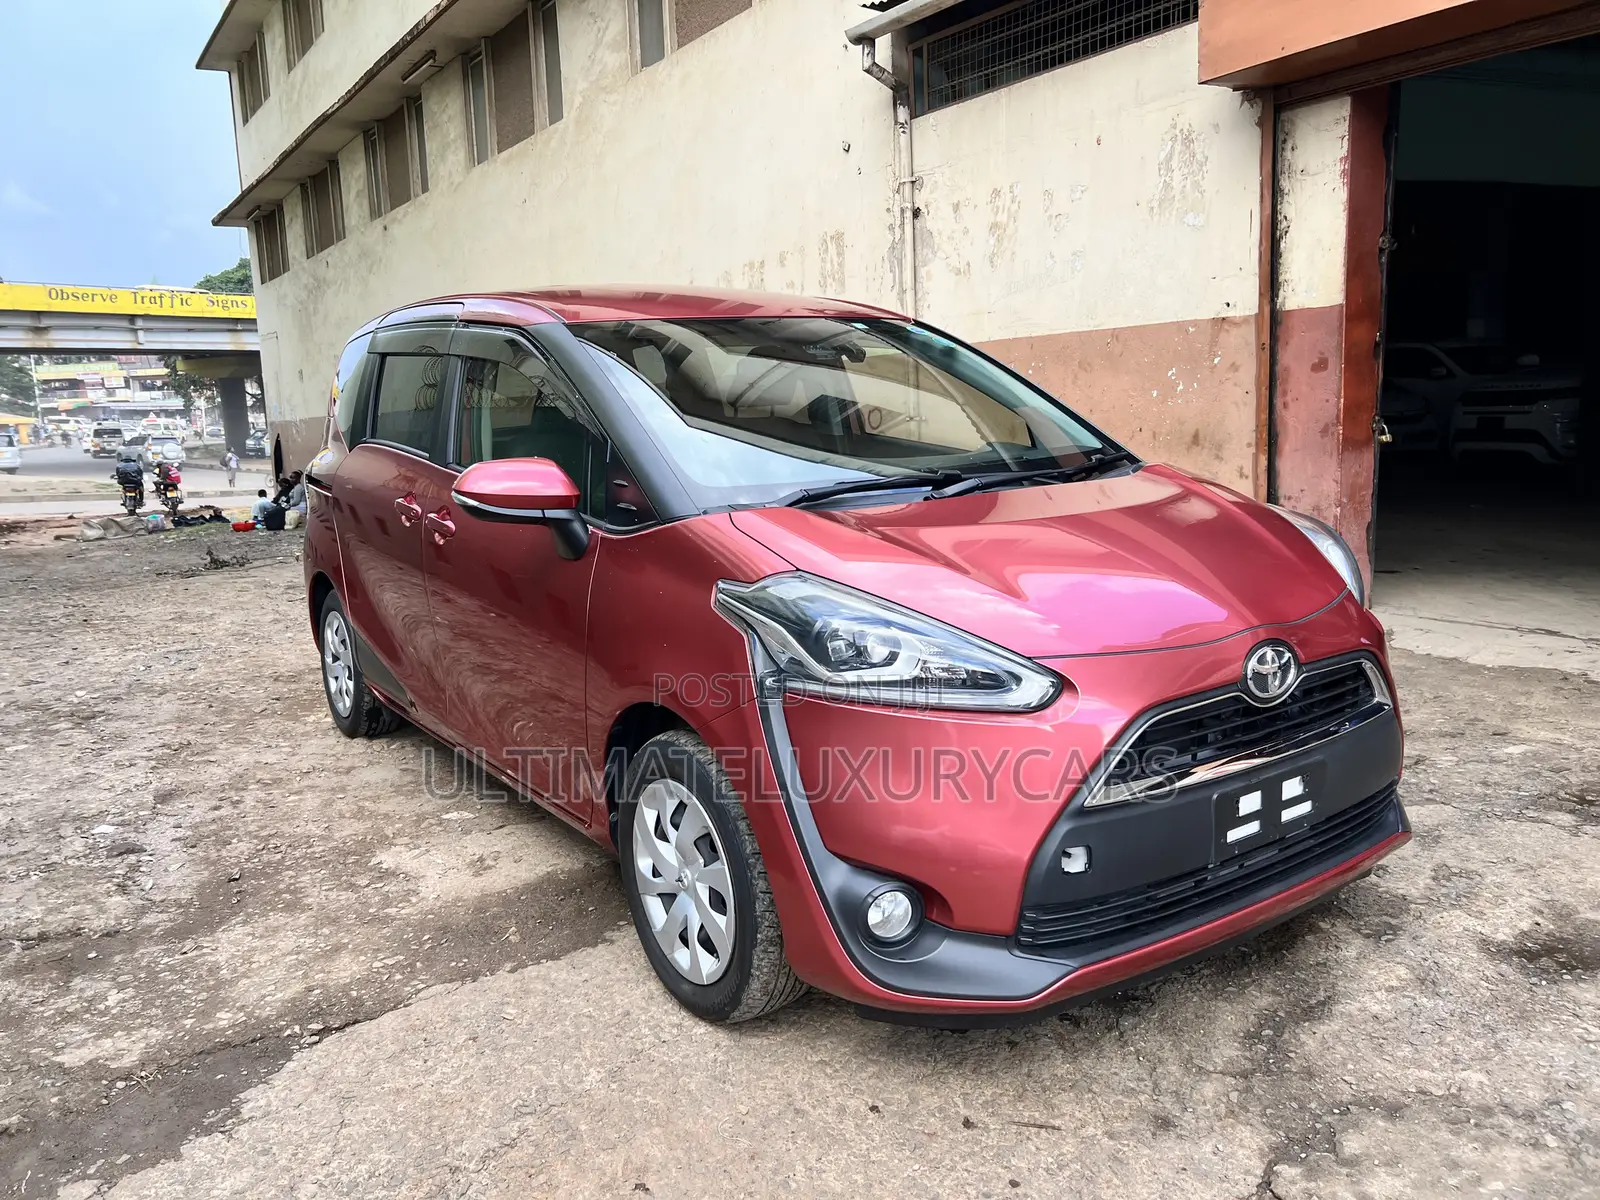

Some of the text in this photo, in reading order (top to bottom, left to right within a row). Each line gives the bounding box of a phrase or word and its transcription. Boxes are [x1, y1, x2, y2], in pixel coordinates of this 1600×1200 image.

[48, 287, 248, 311] Observe Traffic Signs
